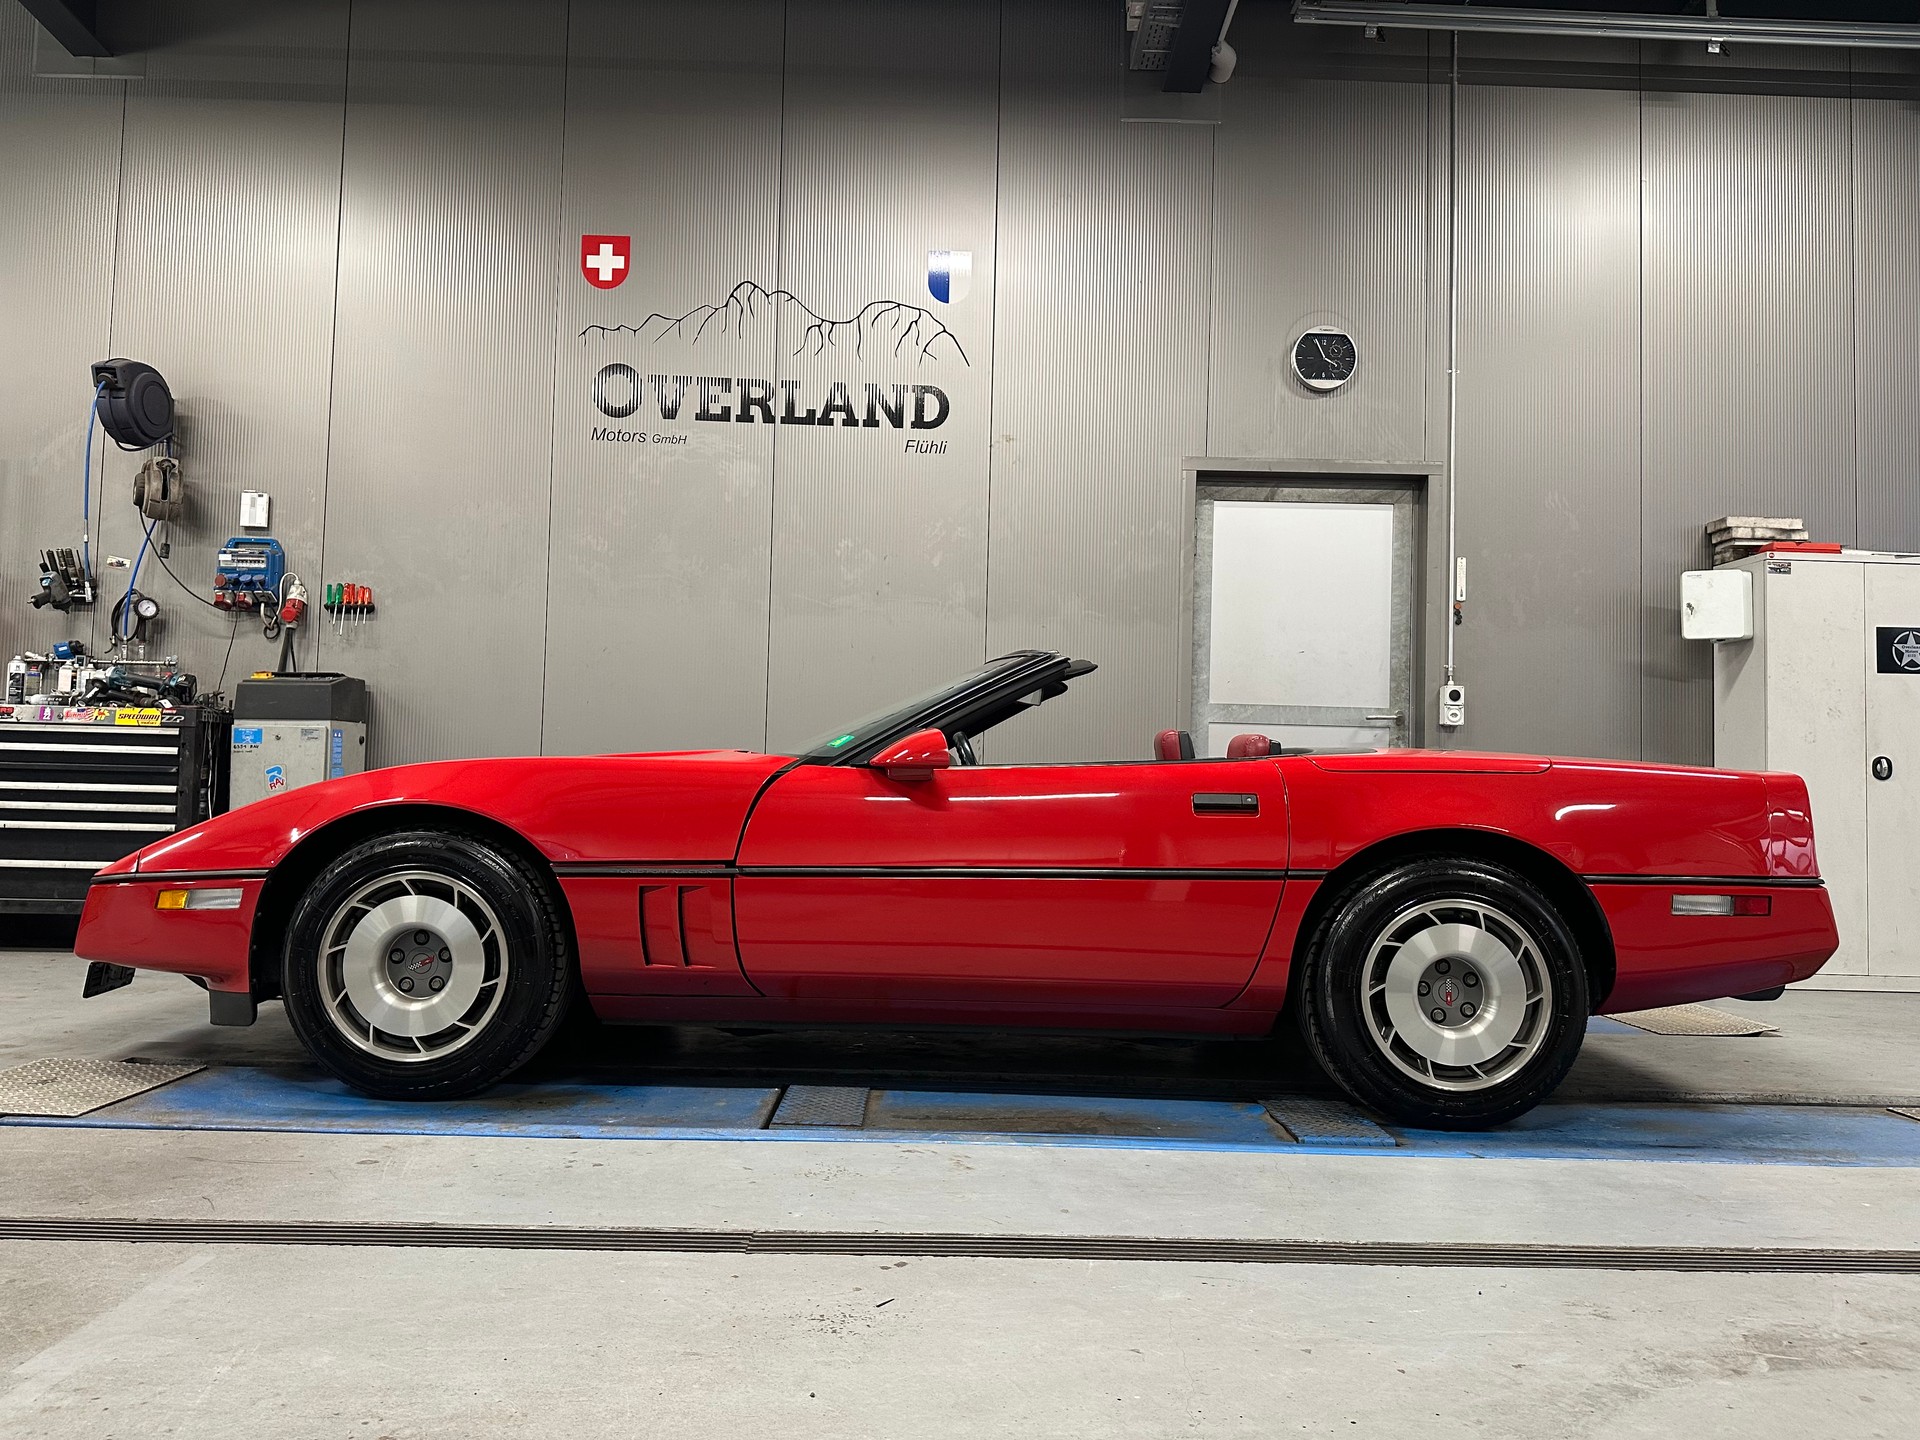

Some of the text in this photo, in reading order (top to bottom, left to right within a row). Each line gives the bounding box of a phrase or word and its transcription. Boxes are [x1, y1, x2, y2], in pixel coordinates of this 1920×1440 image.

[592, 362, 950, 430] OVERLAND
[590, 427, 688, 445] Motors GmbH
[904, 439, 948, 455] Flühli
[118, 713, 160, 721] SPEEDWAY
[269, 778, 286, 790] RAV
